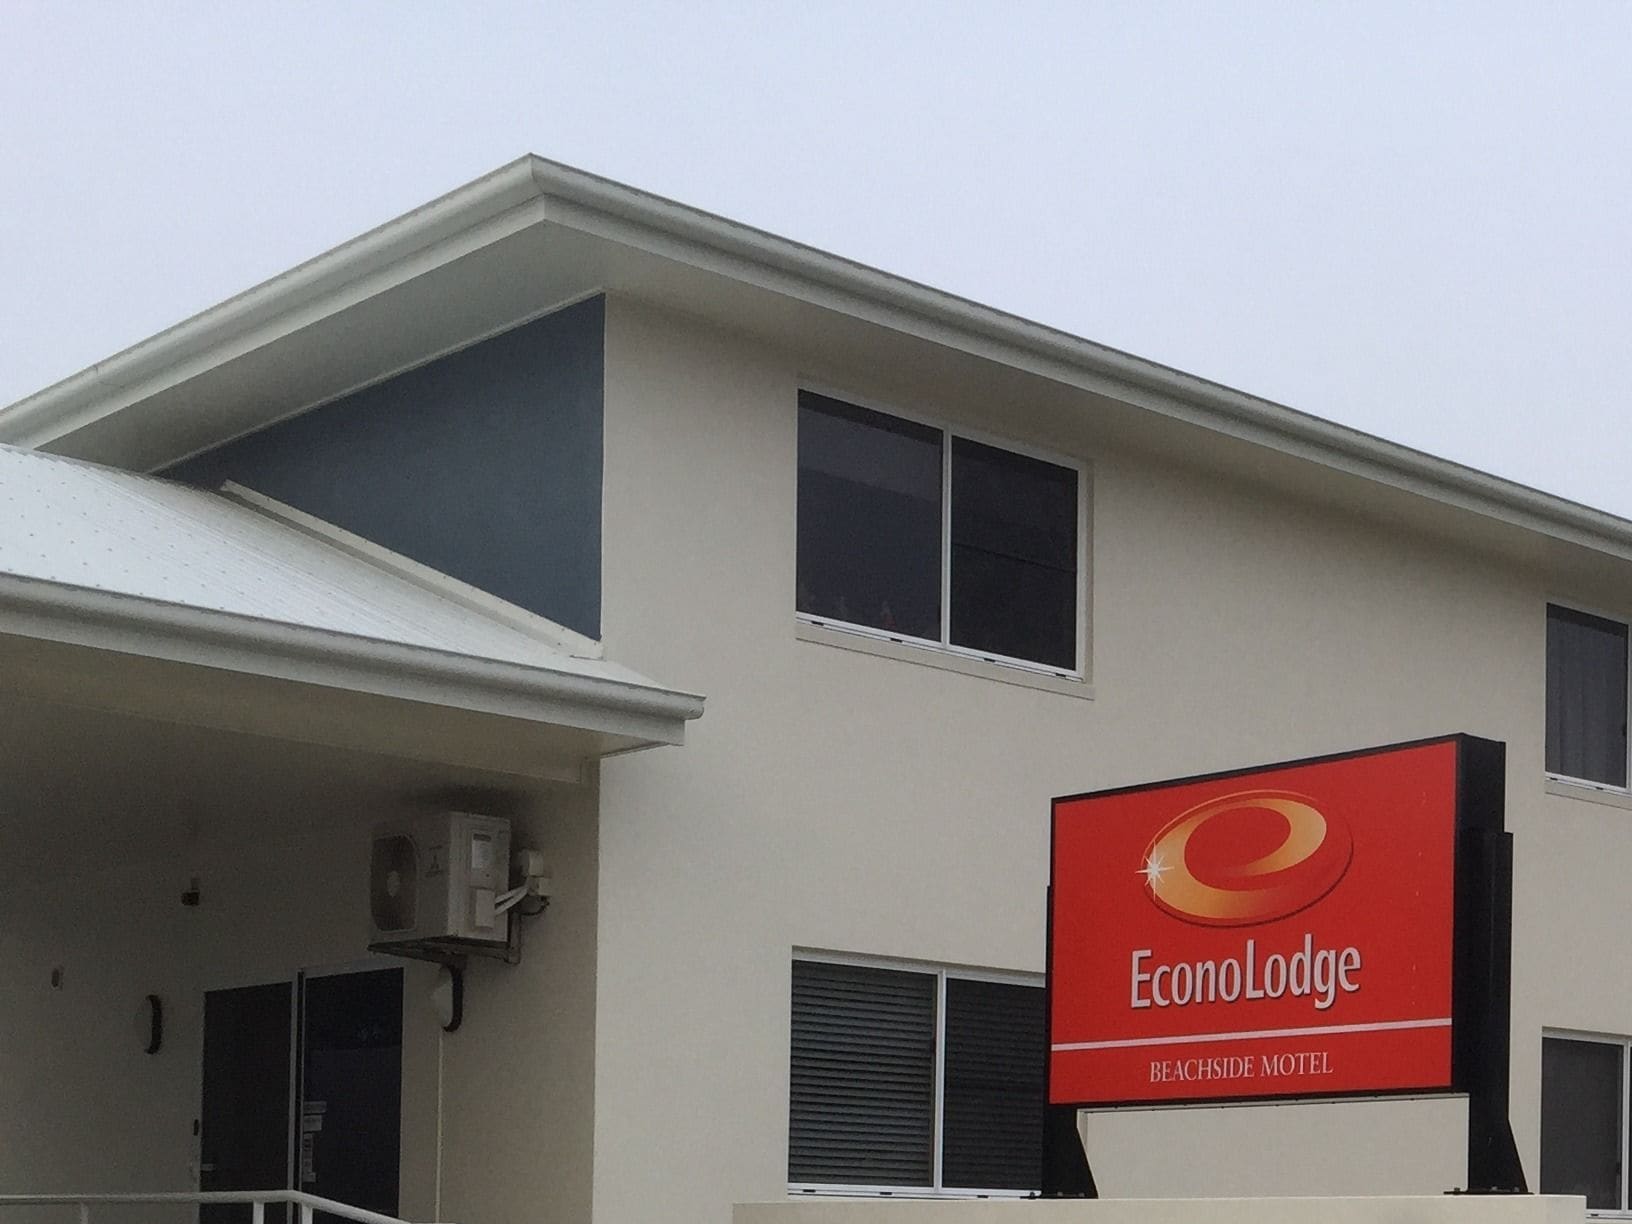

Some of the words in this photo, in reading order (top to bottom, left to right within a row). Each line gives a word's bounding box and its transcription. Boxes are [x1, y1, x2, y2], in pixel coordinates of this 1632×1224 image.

[1130, 933, 1361, 1010] EconoLodge
[1149, 1056, 1255, 1083] BEACHSIDE
[1260, 1051, 1333, 1078] MOTEL
